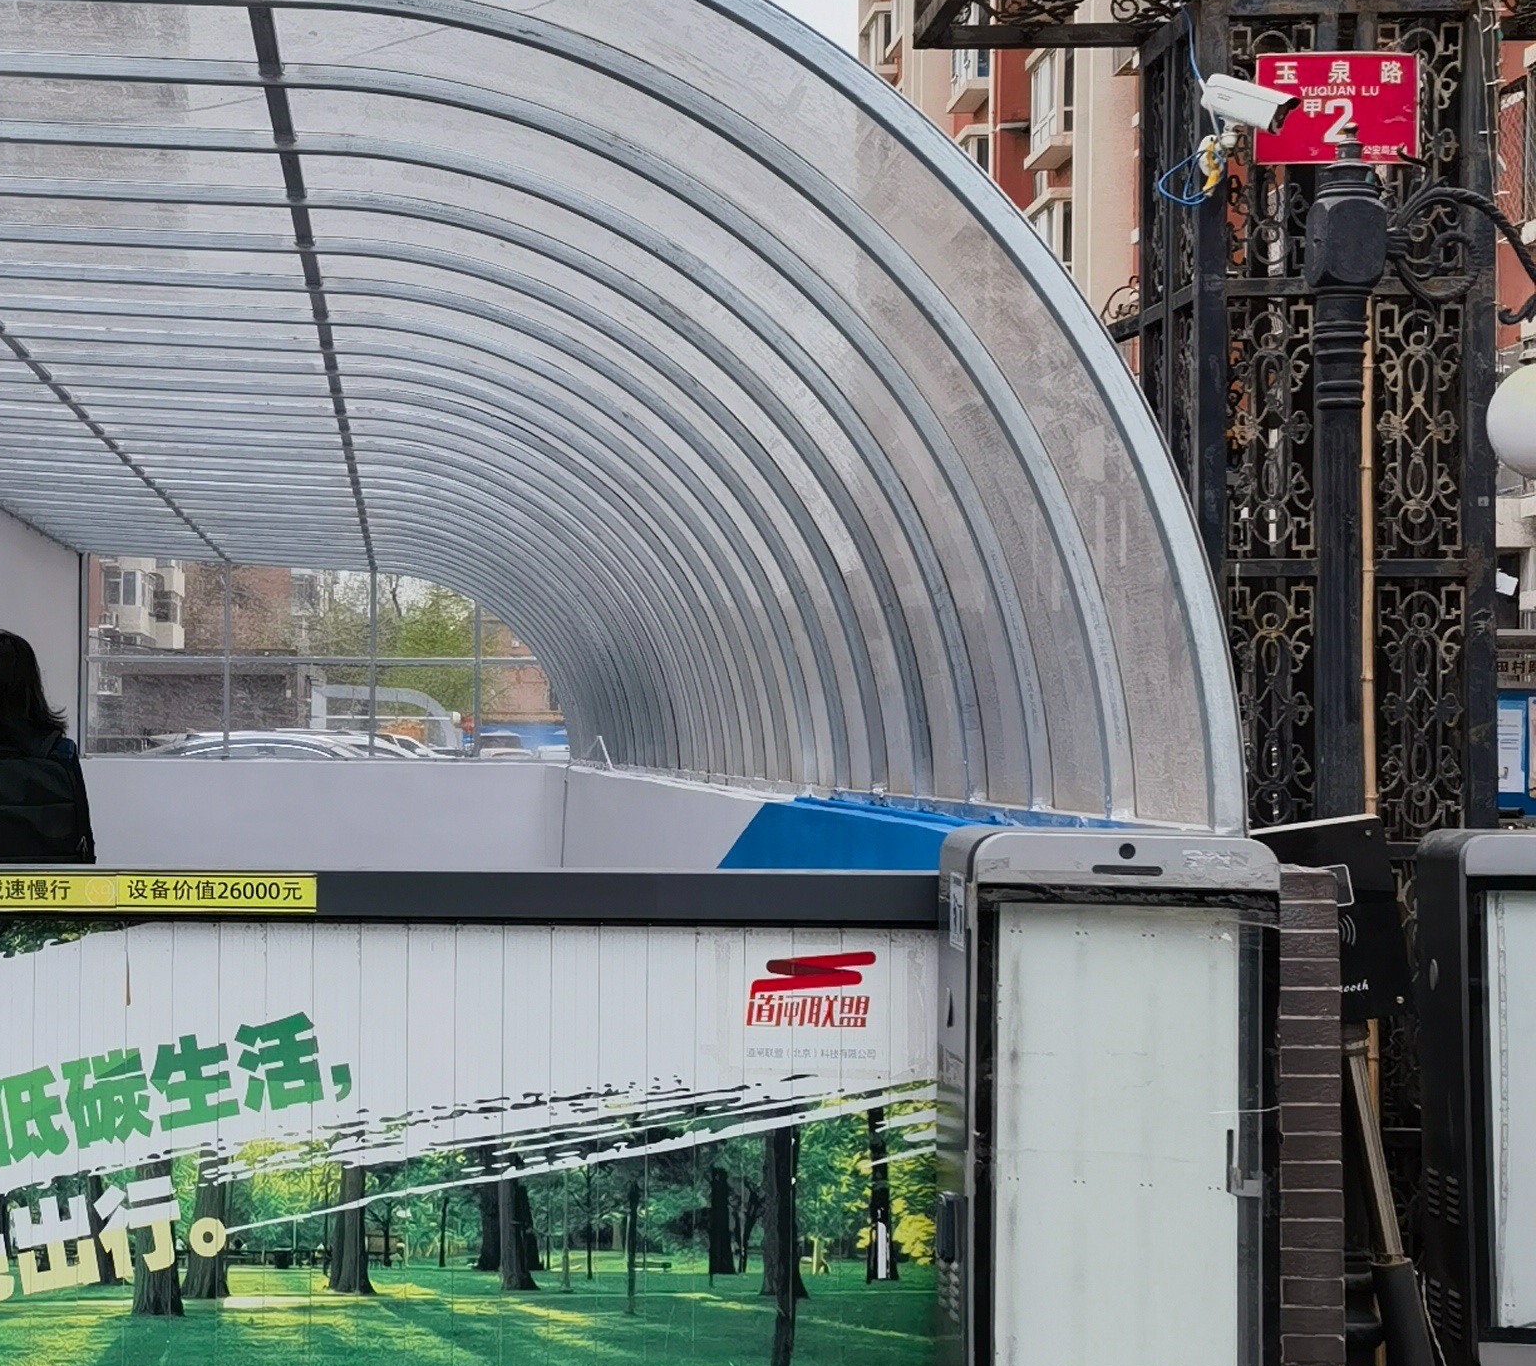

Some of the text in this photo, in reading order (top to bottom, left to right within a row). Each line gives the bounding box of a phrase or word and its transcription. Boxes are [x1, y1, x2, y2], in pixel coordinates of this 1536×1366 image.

[1273, 61, 1403, 84] 玉泉路
[1300, 85, 1380, 97] YUQUAN LU
[127, 878, 304, 901] 设备价值26000元
[745, 993, 871, 1028] 道闸联盟
